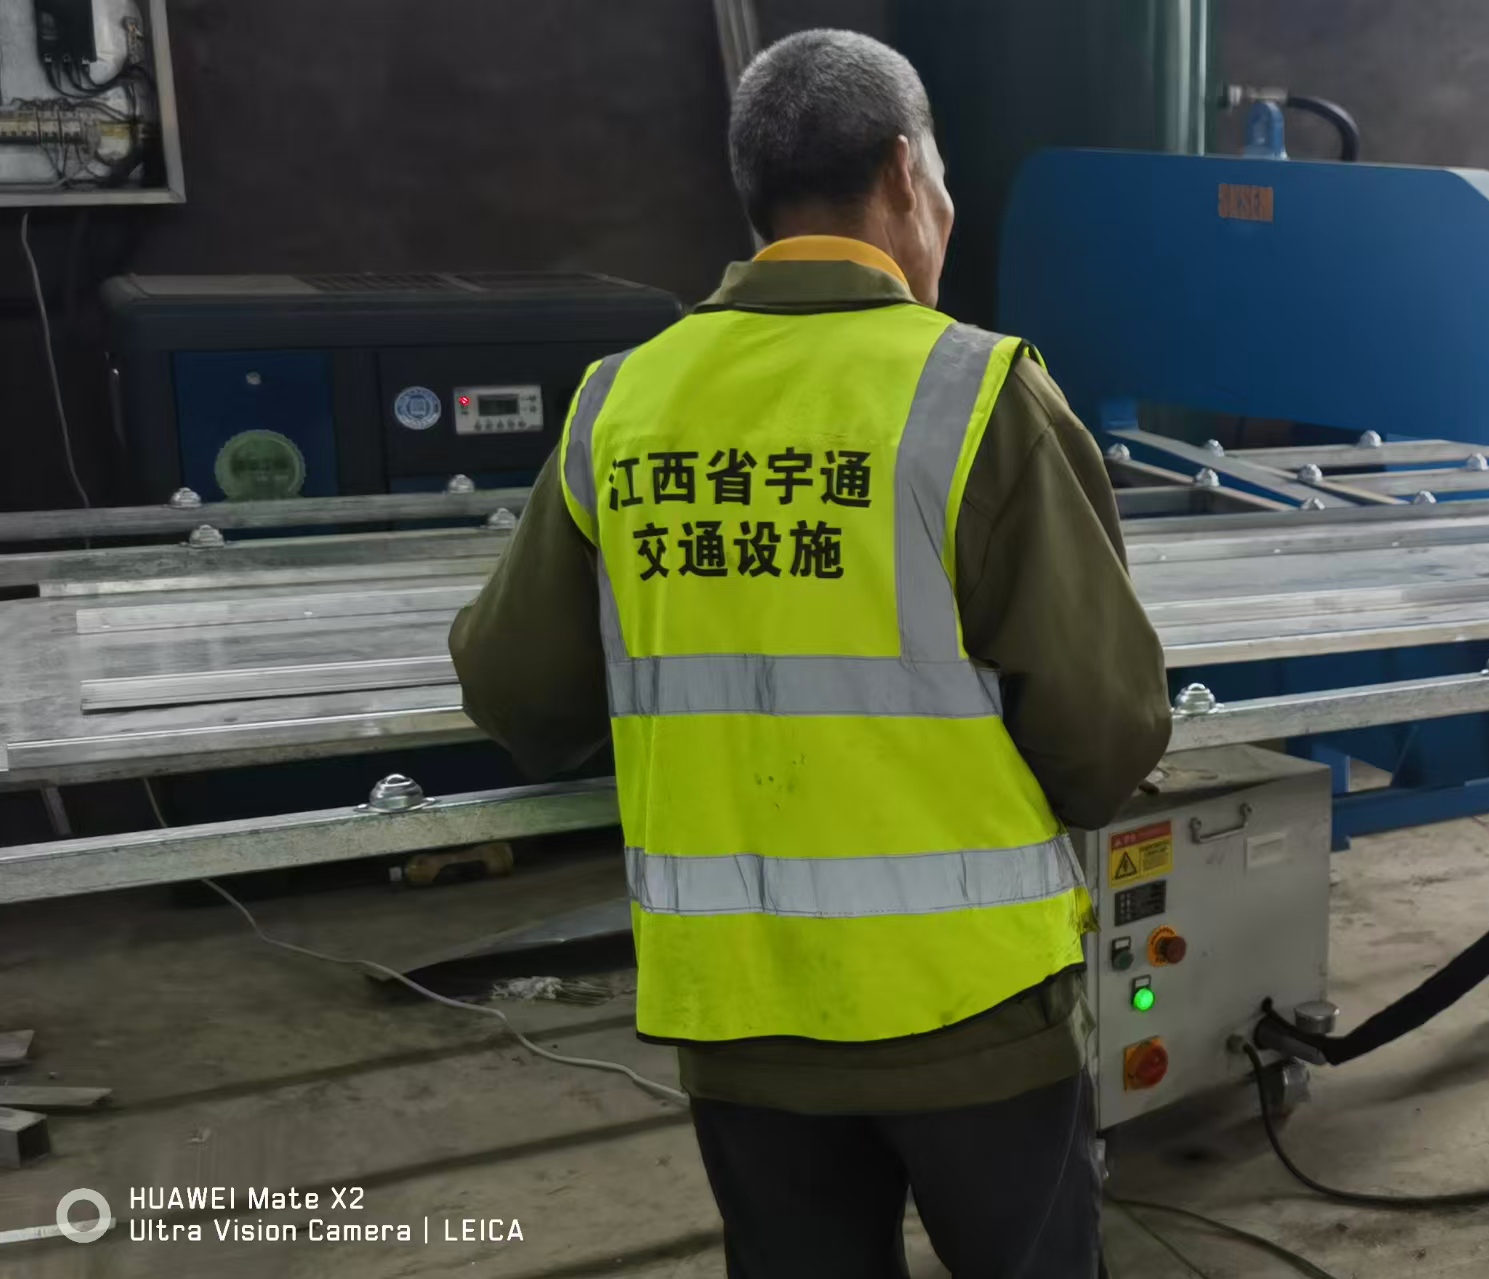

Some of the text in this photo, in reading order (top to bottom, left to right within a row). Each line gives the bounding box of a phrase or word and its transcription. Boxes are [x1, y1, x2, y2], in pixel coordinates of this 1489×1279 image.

[608, 447, 872, 511] 江西省宇通
[633, 520, 844, 581] 交通设施
